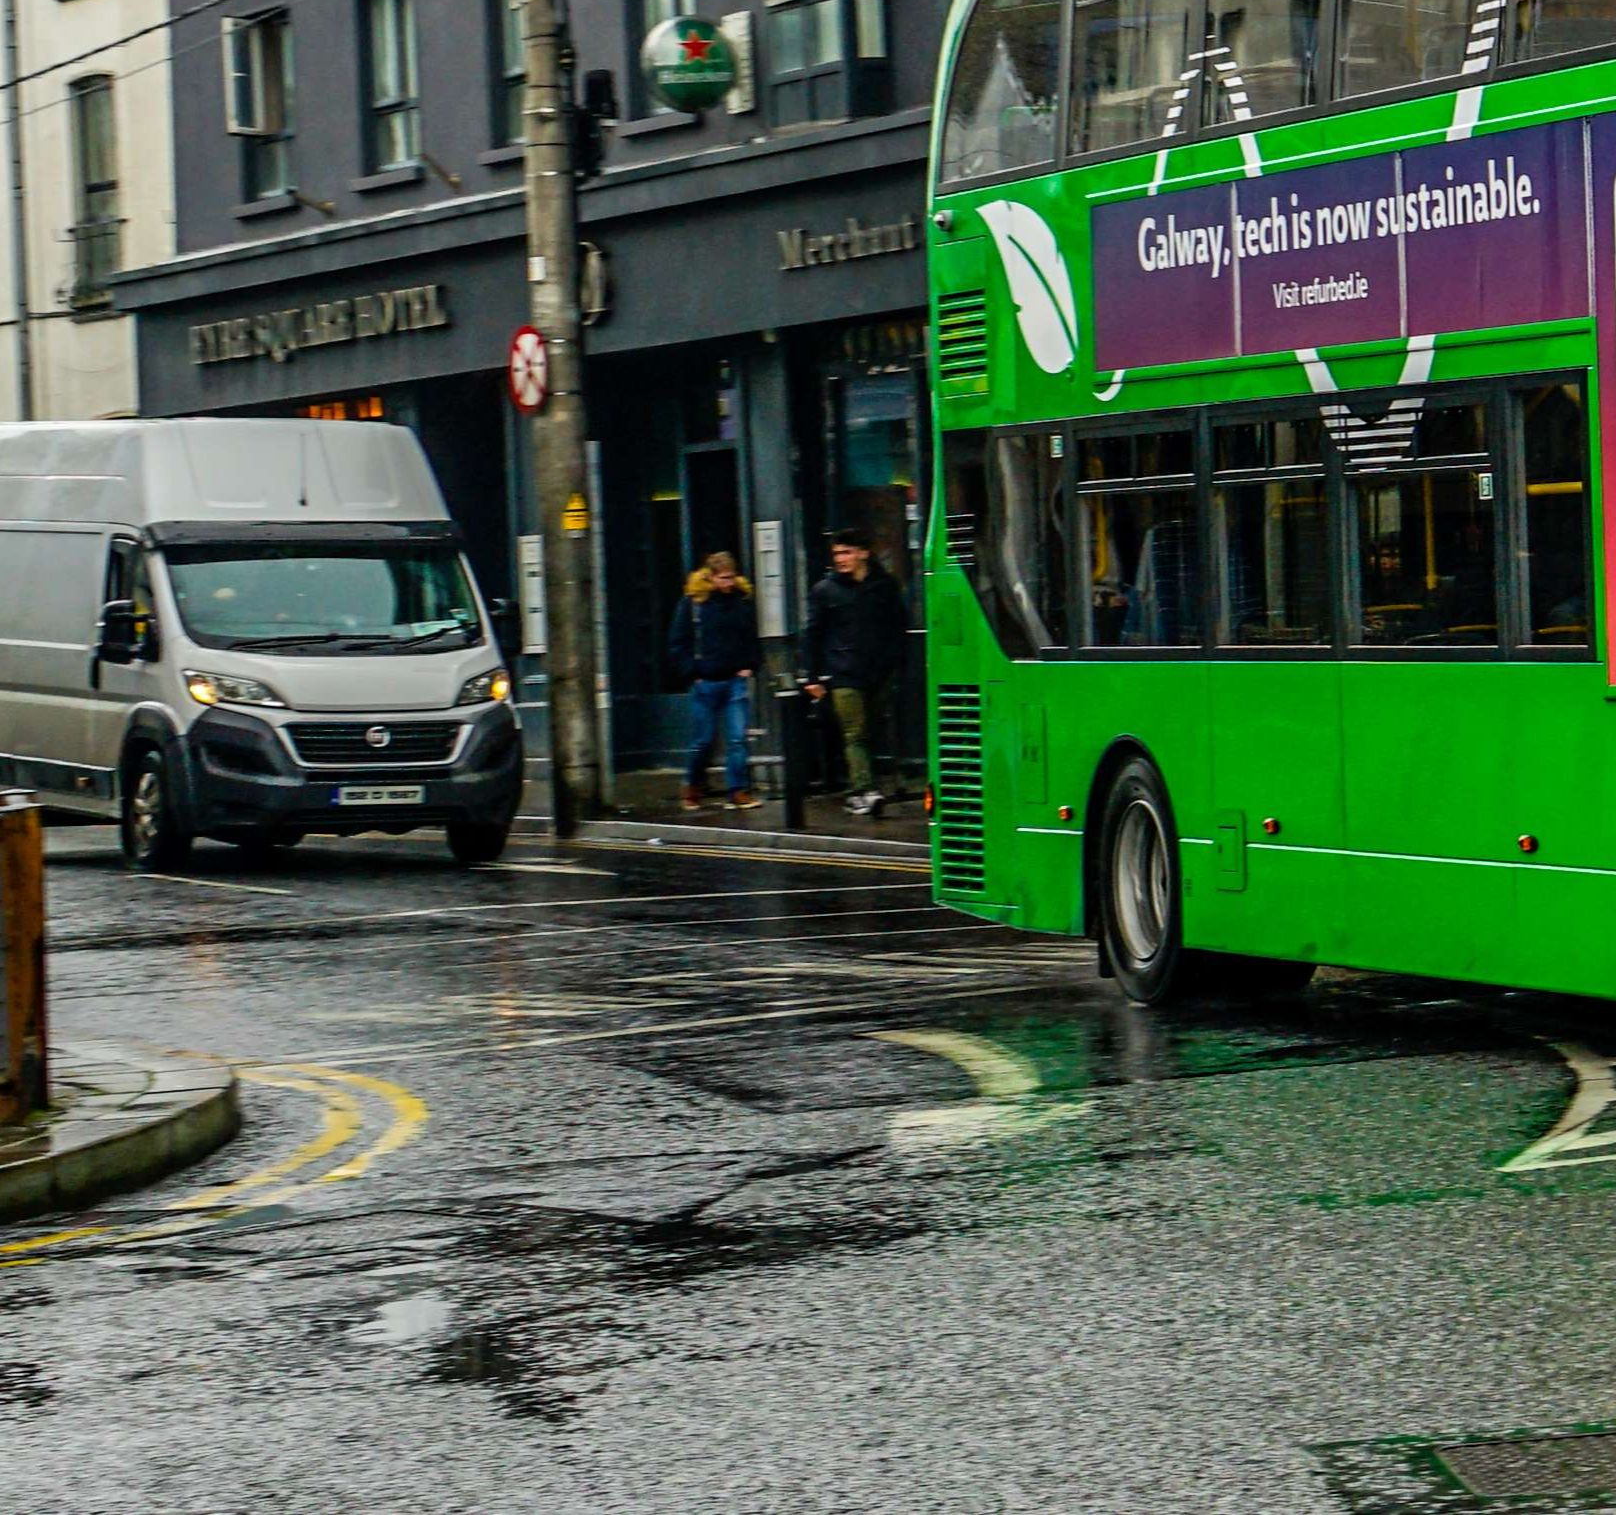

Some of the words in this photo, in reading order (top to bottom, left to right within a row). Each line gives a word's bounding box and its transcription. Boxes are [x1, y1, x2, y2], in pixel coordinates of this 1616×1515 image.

[1138, 215, 1231, 278] Galway,
[1234, 196, 1288, 258] tech
[1291, 193, 1312, 250] is
[1316, 200, 1370, 246] now
[1377, 156, 1540, 238] sustainable.
[1272, 281, 1300, 308] Visit
[1301, 271, 1369, 305] refurbed.ie
